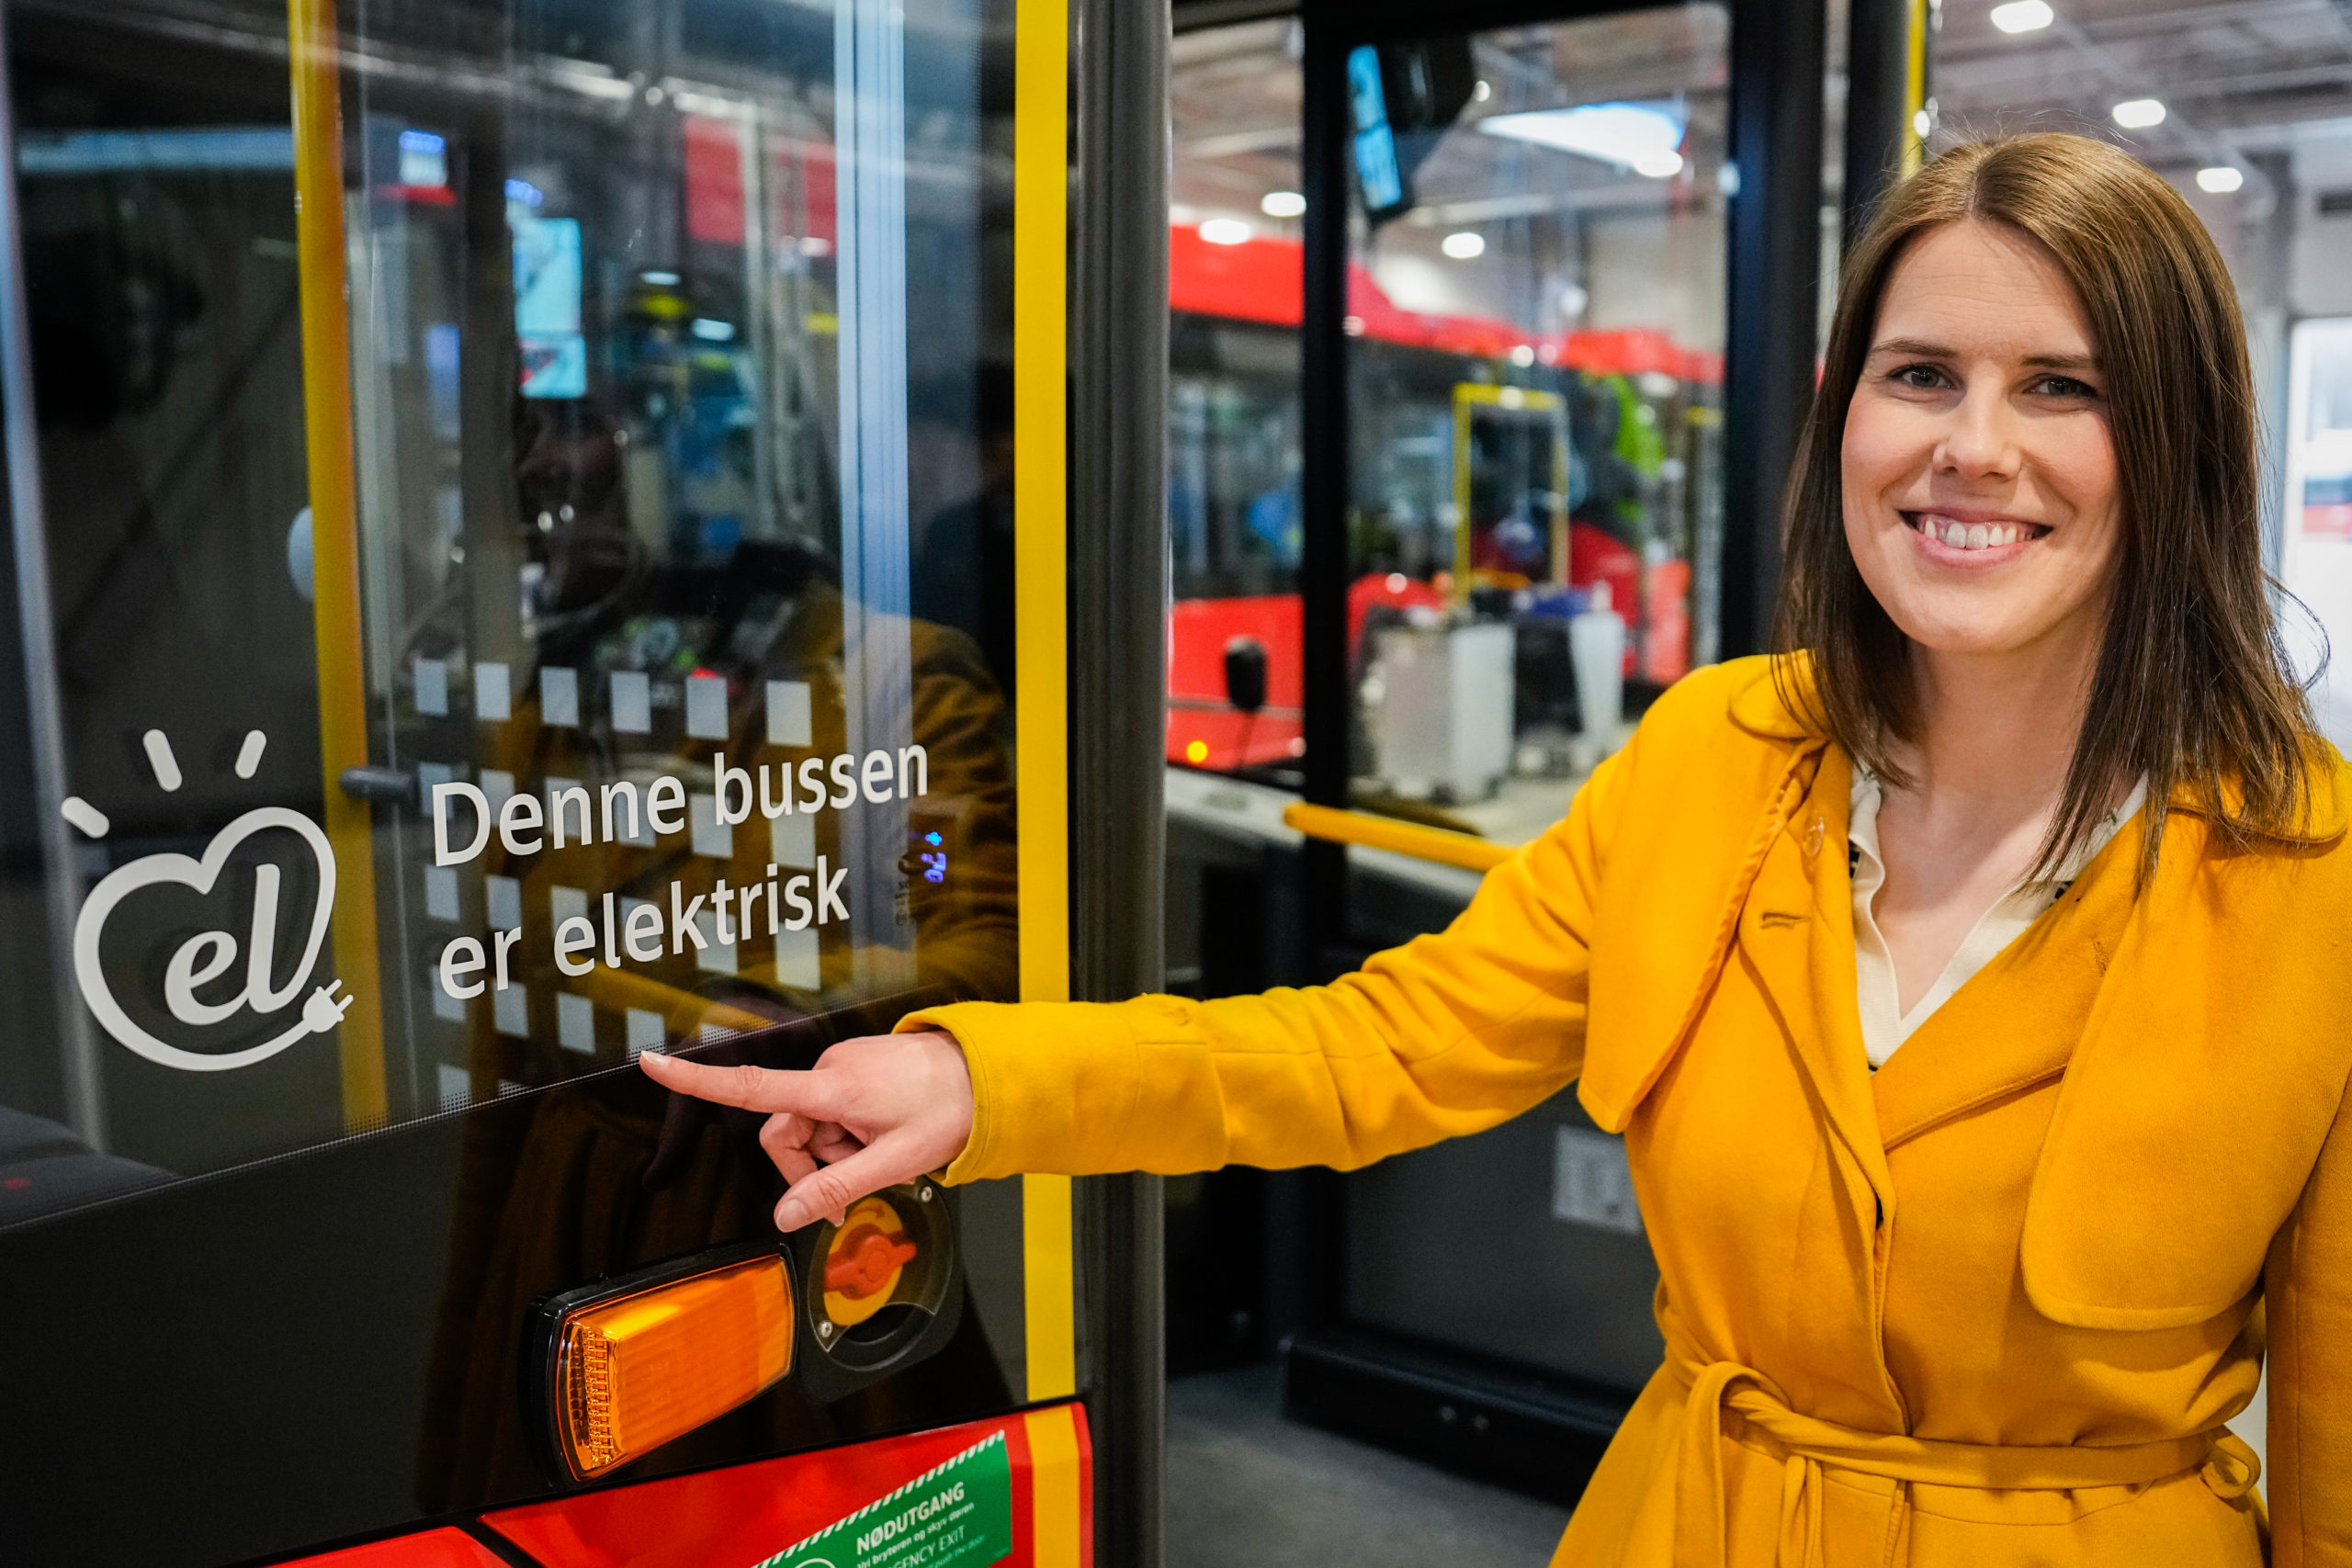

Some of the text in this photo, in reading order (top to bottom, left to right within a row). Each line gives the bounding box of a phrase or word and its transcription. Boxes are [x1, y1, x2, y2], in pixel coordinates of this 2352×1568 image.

[432, 743, 928, 867] Denne bussen
[164, 863, 281, 1026] el
[439, 926, 522, 1000] er
[553, 854, 851, 977] elektrisk
[857, 1481, 965, 1556] NØDUTGANG
[872, 1537, 912, 1565] bryteren
[913, 1529, 926, 1541] og
[927, 1516, 948, 1534] skyv
[888, 1524, 966, 1568] GENCY EXIT
